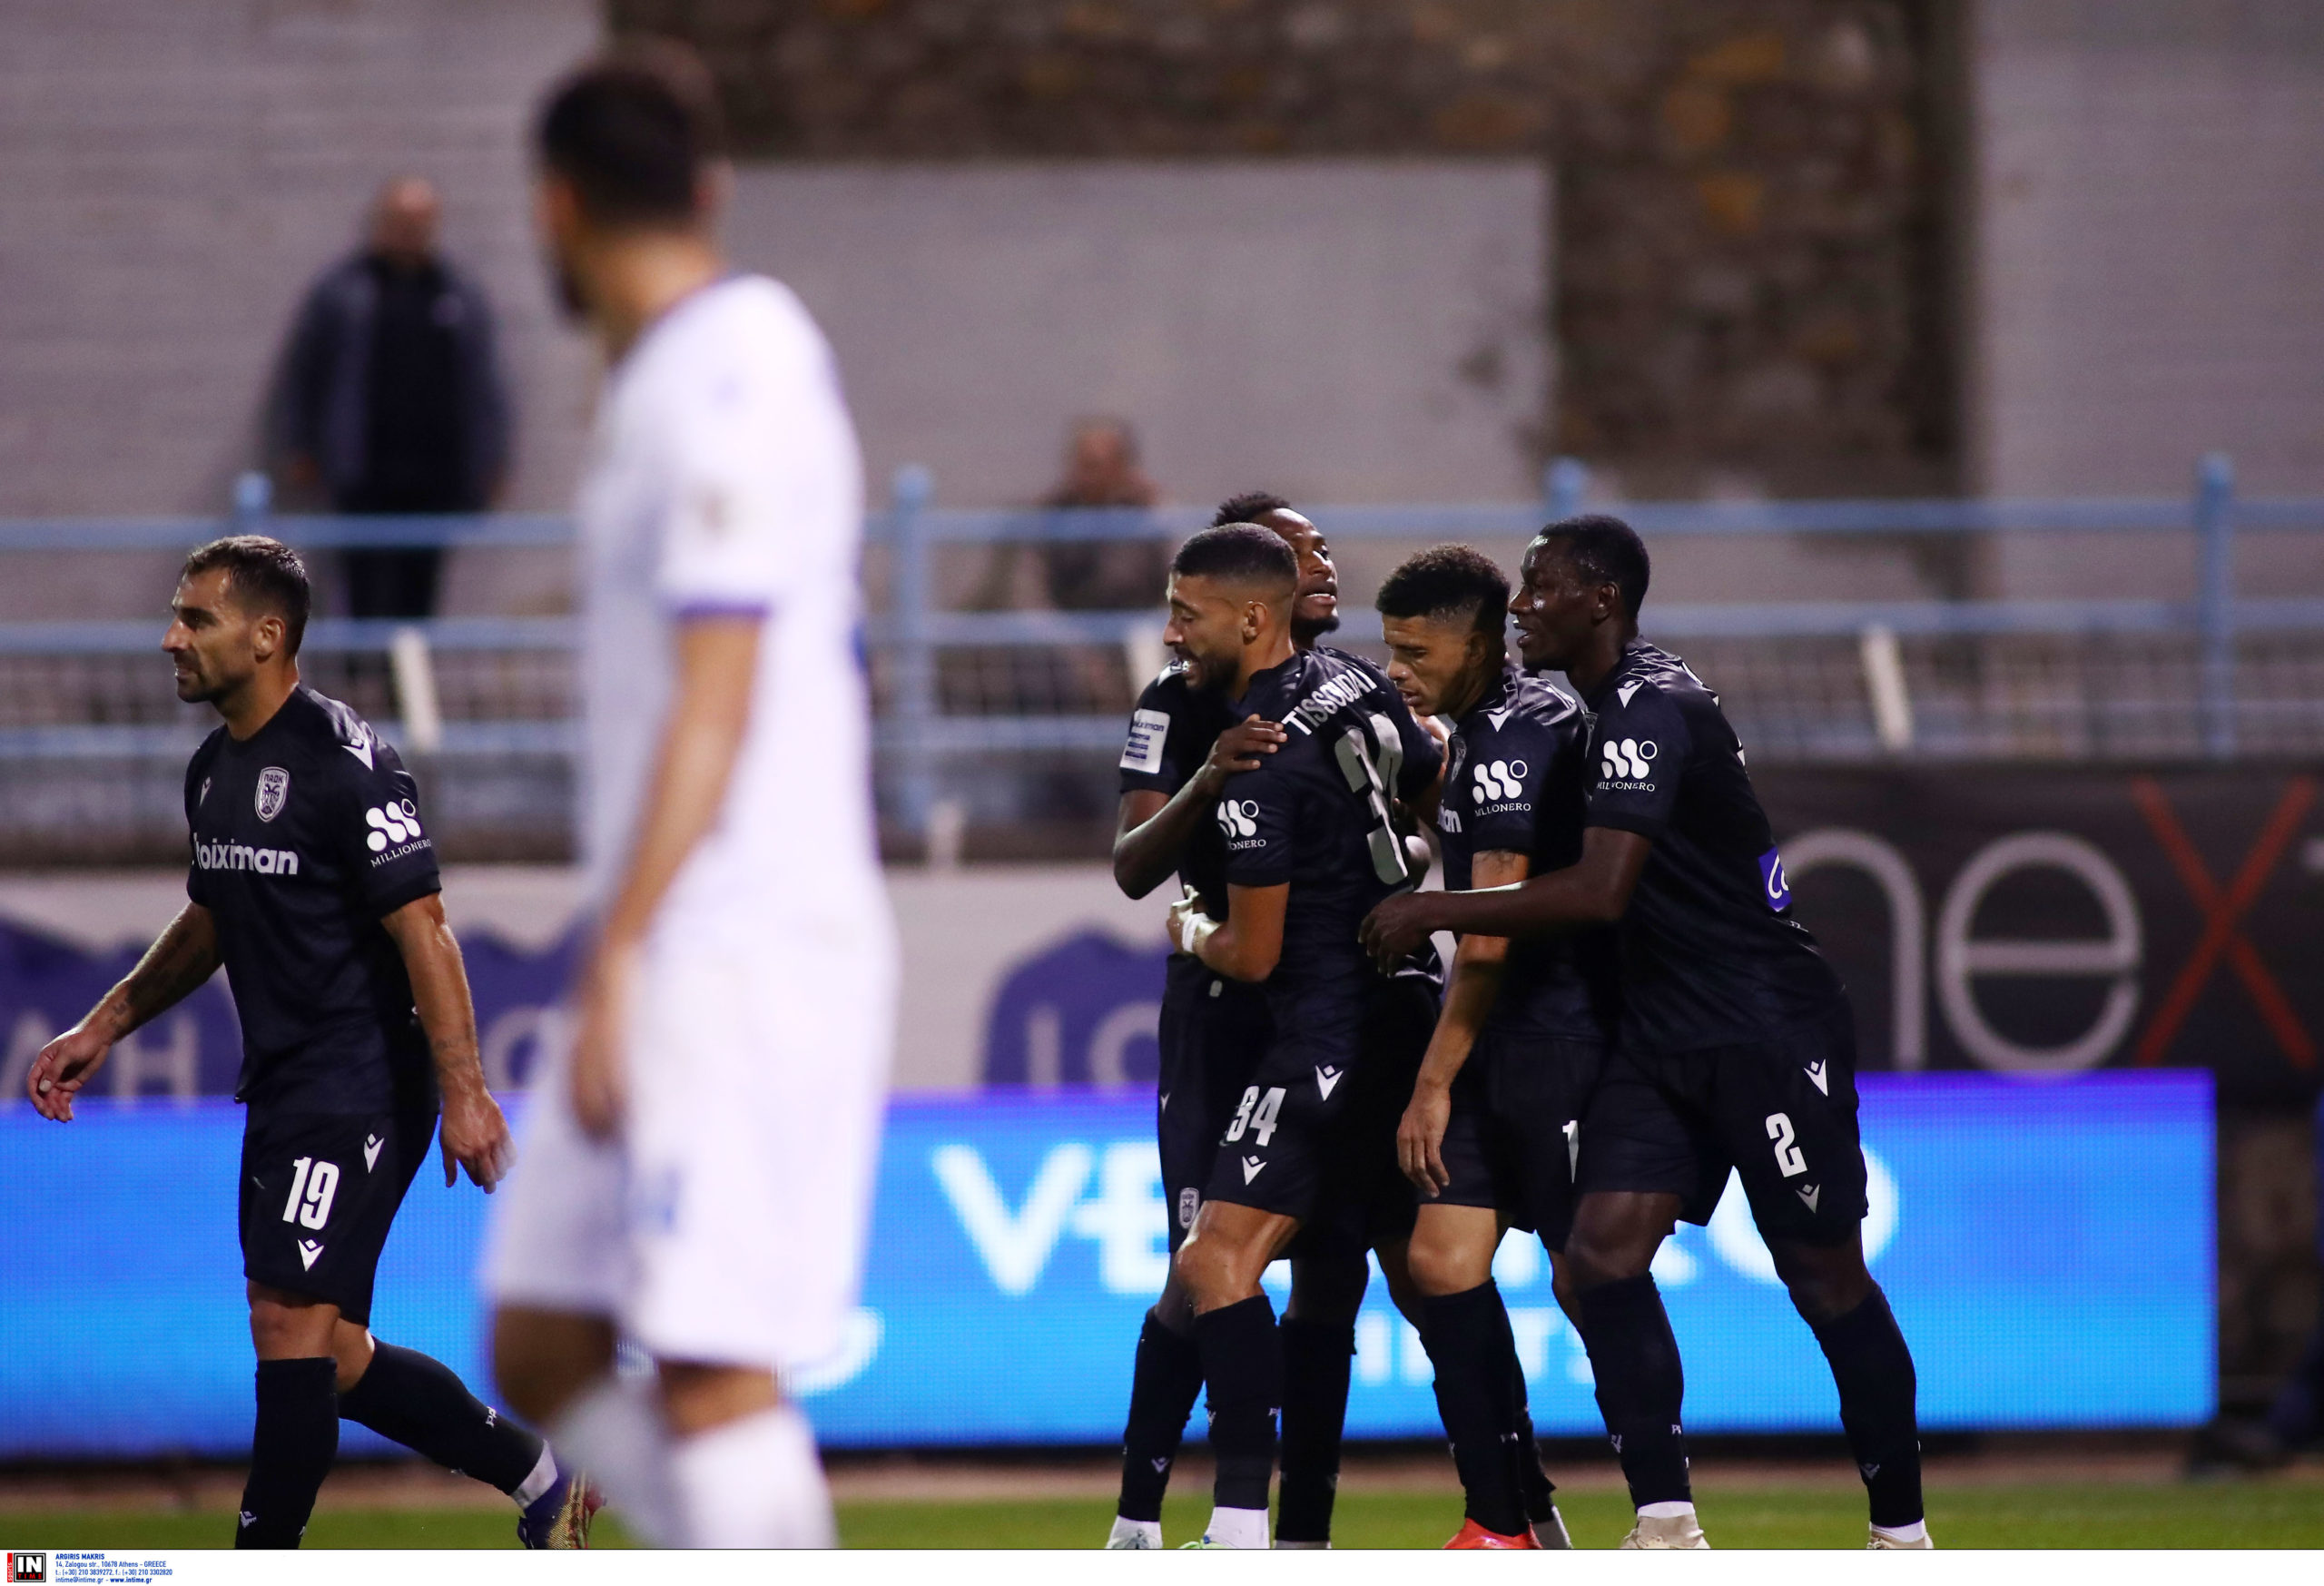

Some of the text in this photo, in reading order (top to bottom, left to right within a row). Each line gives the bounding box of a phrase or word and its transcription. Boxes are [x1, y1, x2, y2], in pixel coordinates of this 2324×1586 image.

[370, 838, 432, 868] MILLIONERO
[1220, 1085, 1287, 1148] 34
[1765, 1112, 1808, 1177] 2
[281, 1156, 340, 1231] 19
